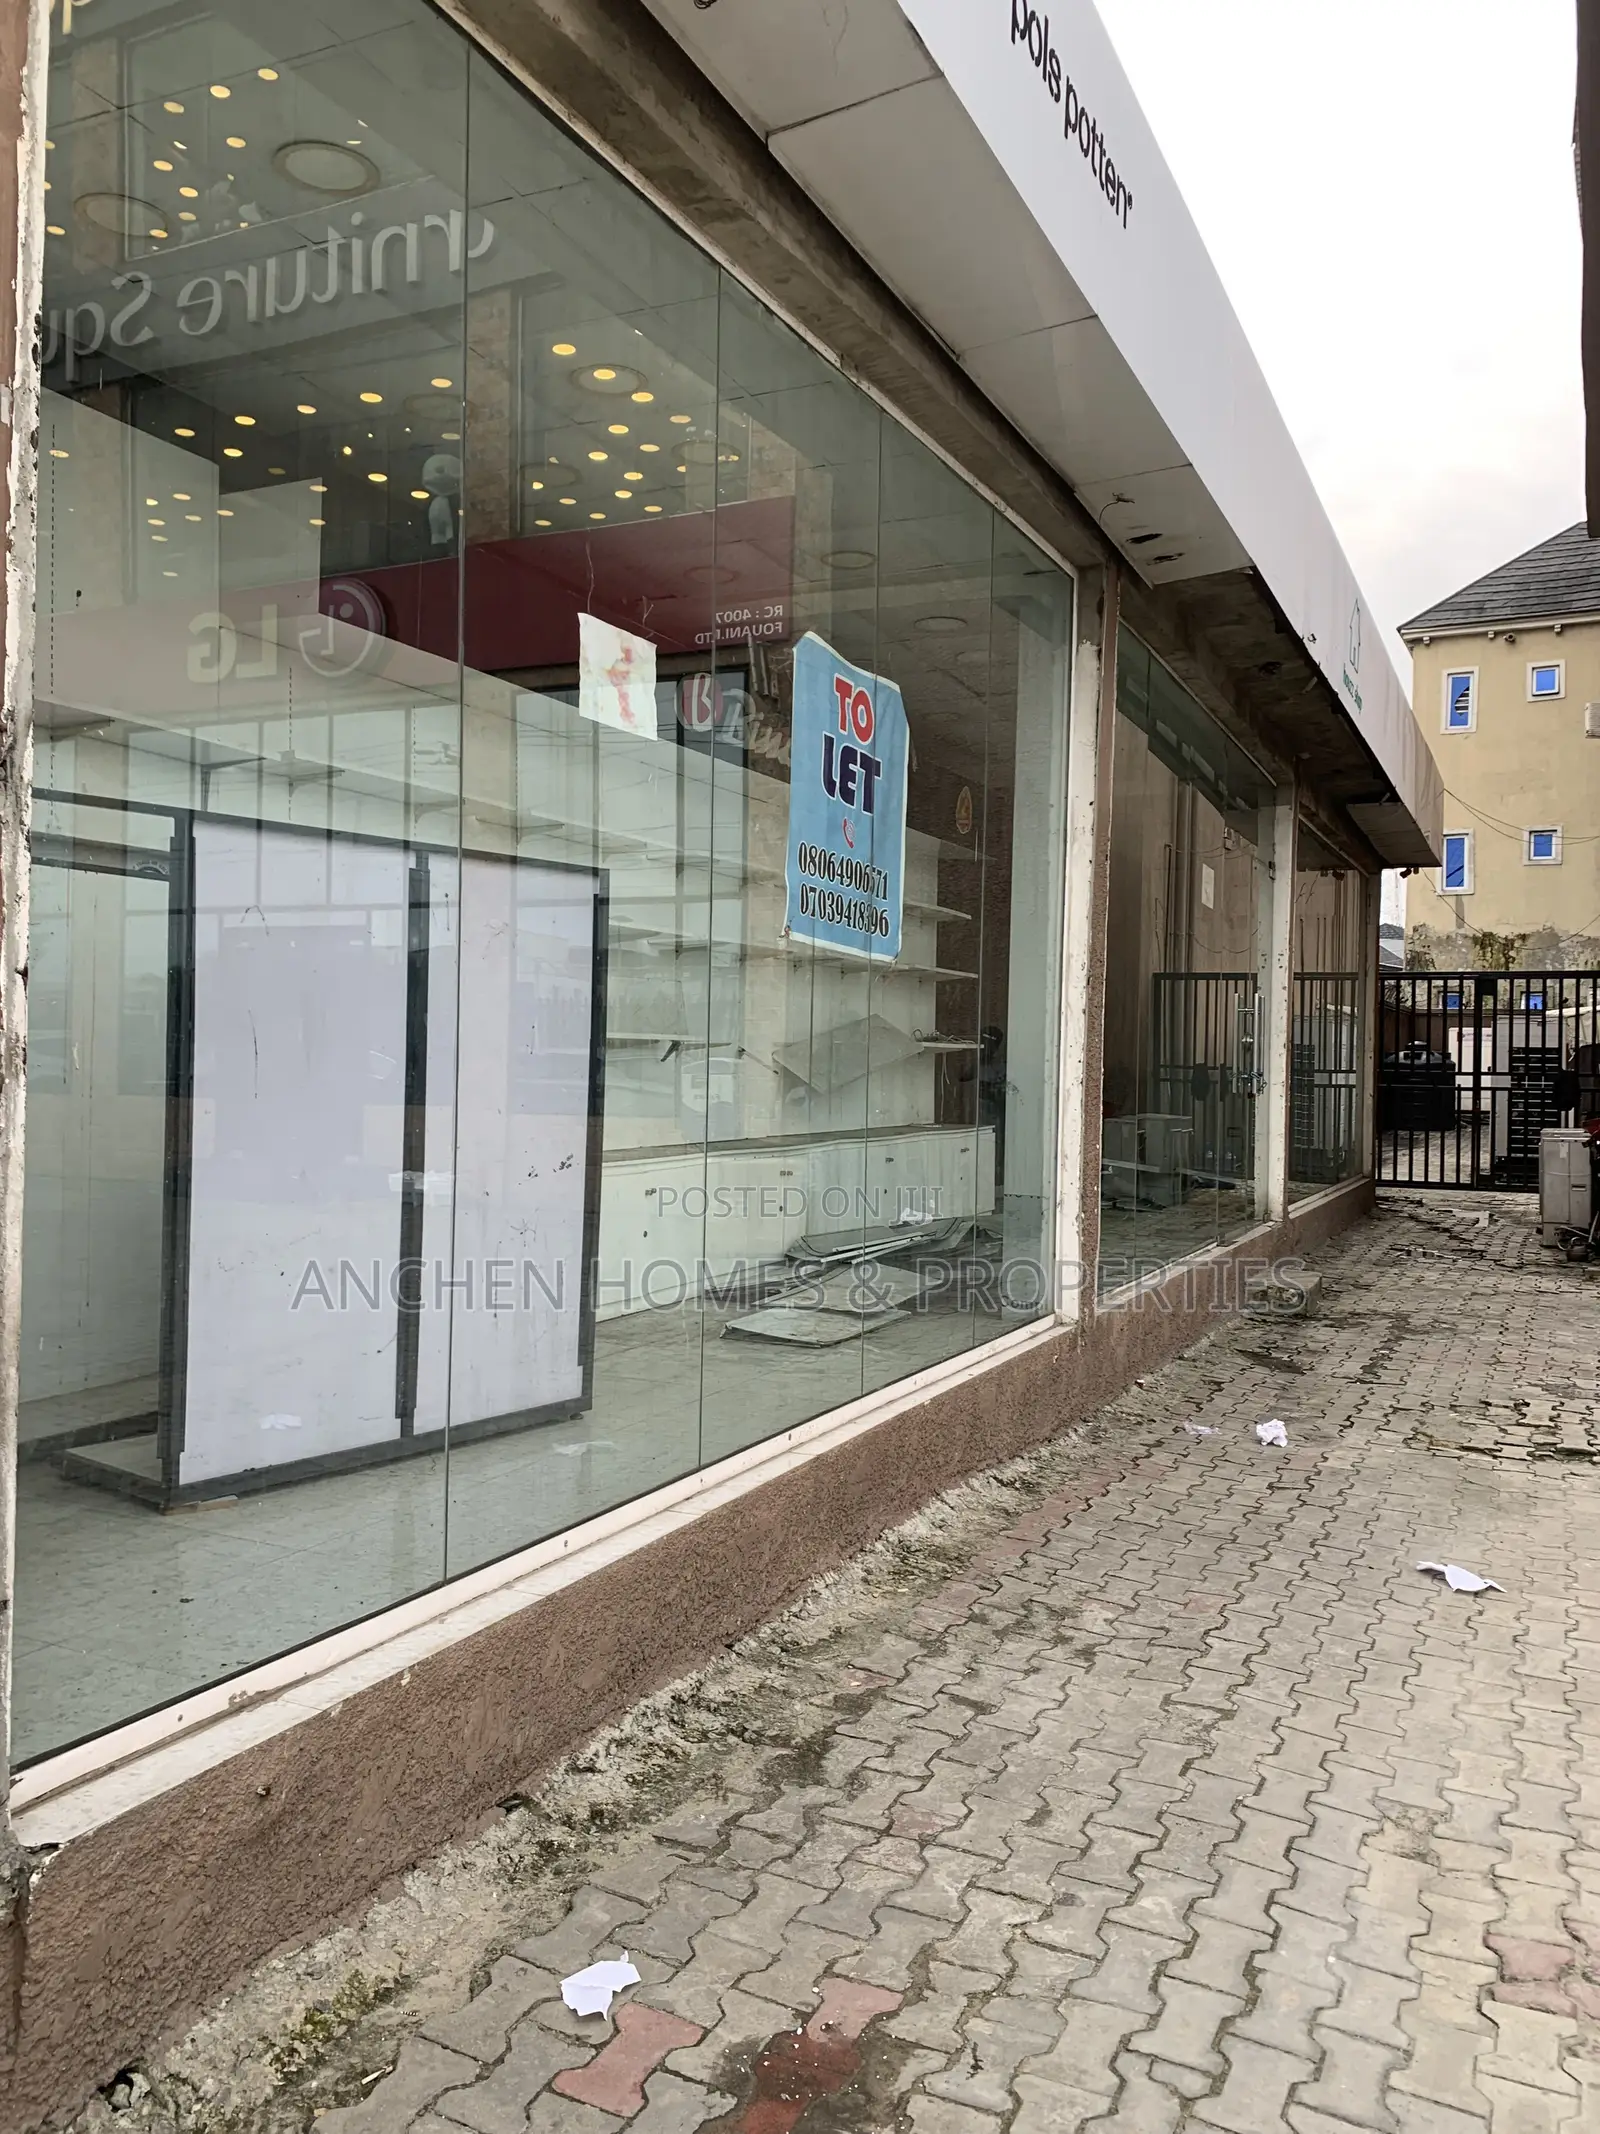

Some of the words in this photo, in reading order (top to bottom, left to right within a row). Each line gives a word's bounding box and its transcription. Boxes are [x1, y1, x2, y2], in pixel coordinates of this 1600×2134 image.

[1010, 0, 1061, 103] pols
[834, 673, 875, 745] TO
[821, 731, 882, 815] LET
